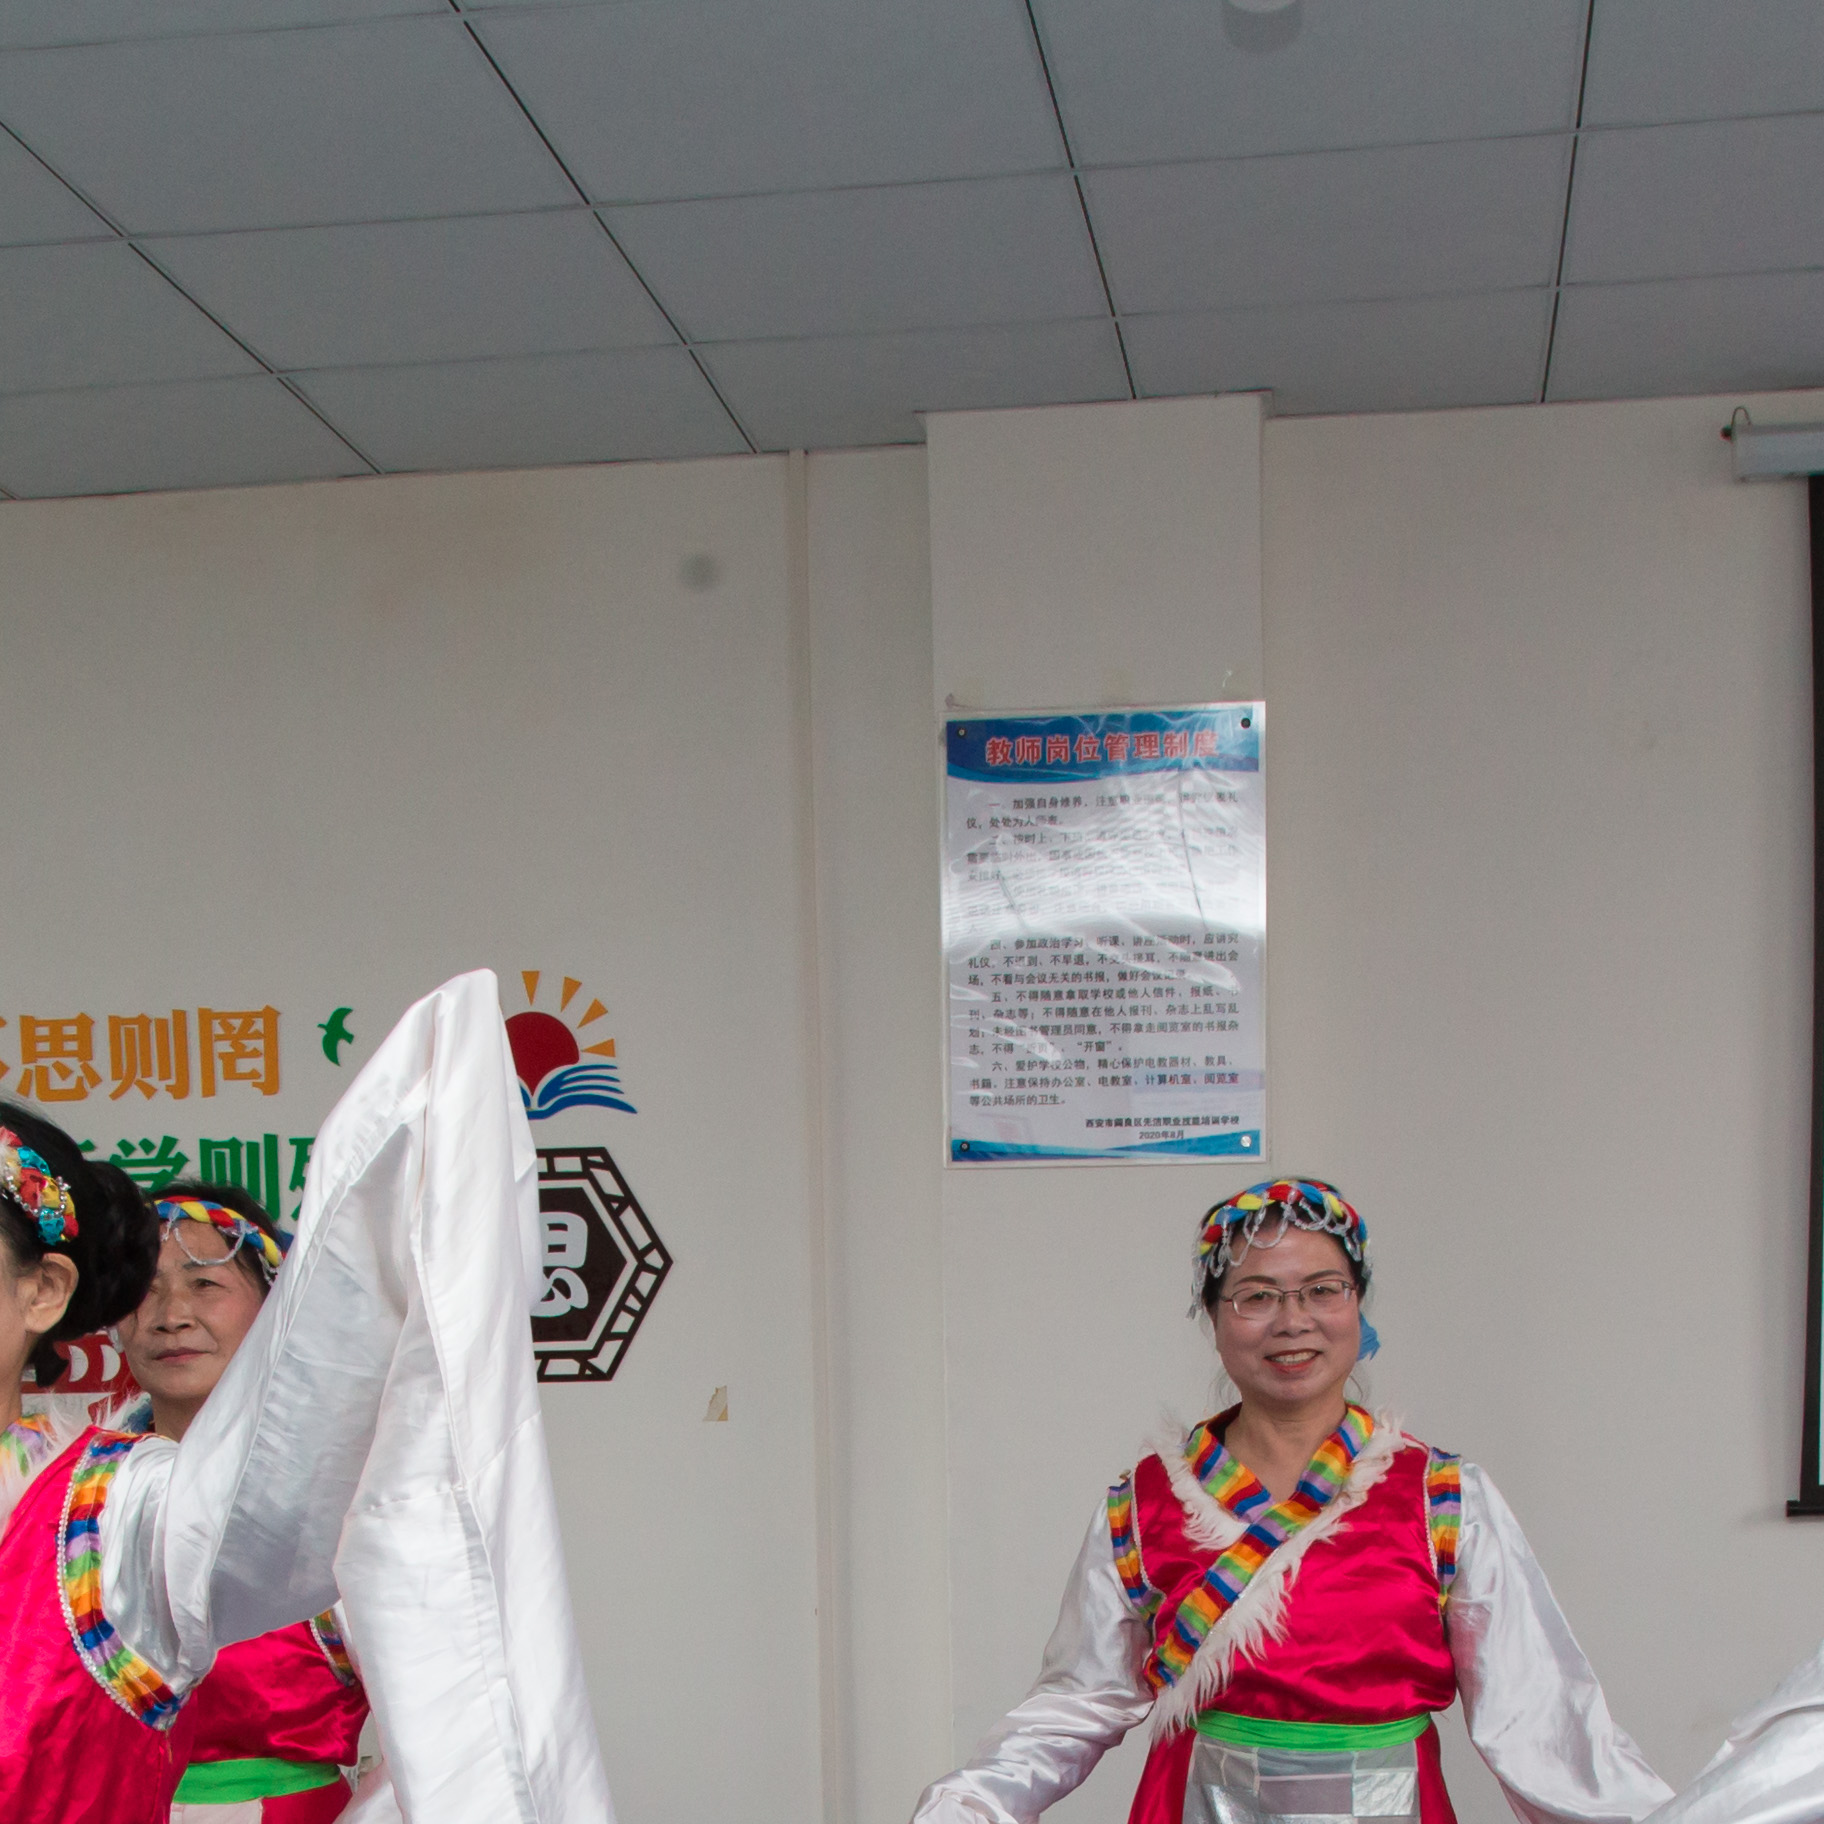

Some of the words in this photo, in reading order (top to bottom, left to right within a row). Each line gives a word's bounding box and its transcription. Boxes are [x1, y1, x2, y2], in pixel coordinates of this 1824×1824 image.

[986, 732, 1219, 766] 教师岗位管理制度
[1138, 1129, 1185, 1141] 2020年8月
